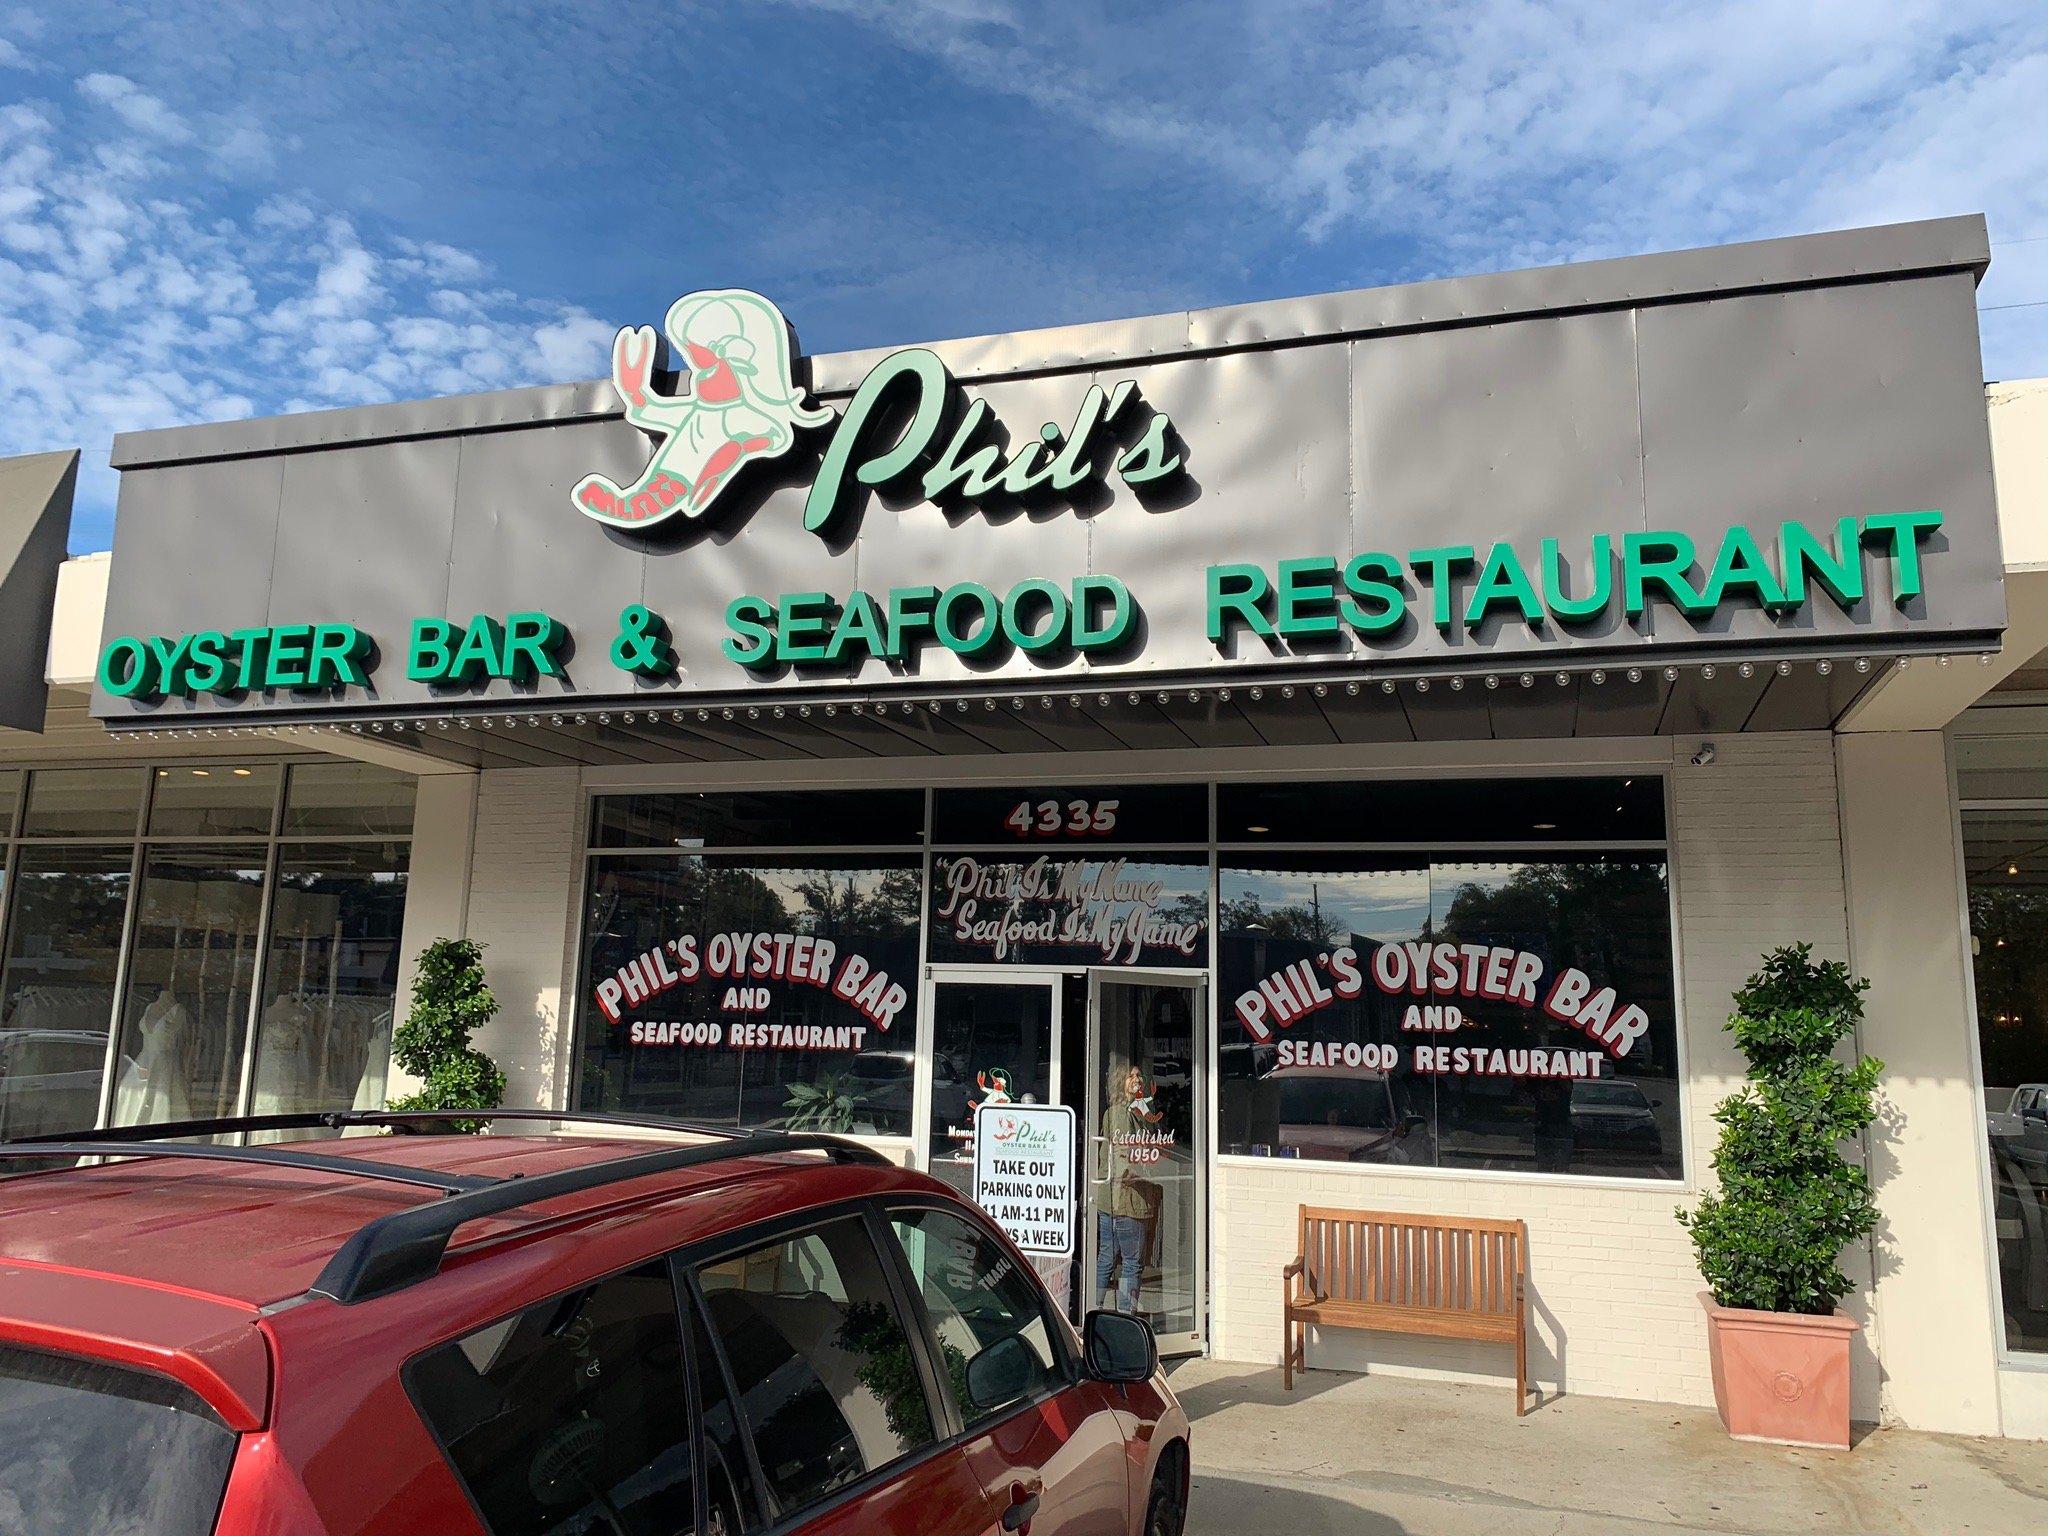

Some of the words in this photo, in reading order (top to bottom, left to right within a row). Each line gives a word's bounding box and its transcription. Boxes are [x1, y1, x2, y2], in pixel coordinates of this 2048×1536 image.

[803, 348, 1183, 532] Phil's
[100, 622, 366, 697] OYSTER
[407, 613, 560, 683] BAR
[610, 603, 668, 675] &
[721, 575, 1136, 669] SEAFOOD
[1206, 510, 1942, 641] RESTAURANT
[1005, 799, 1119, 837] 4335
[955, 899, 1057, 961] Seafood
[1087, 903, 1126, 962] My
[596, 934, 700, 1024] PHIL'S
[705, 932, 836, 985] OYSTER
[832, 954, 907, 1031] BAR
[721, 987, 771, 1011] AND
[1235, 947, 1362, 1042] PHIL'S
[1373, 942, 1544, 1007] OYSTER
[1544, 967, 1649, 1058] BAR
[1402, 1005, 1462, 1032] AND
[630, 1021, 722, 1046] SEAFOOD
[729, 1023, 867, 1050] RESTAURANT
[1277, 1040, 1398, 1071] SEAFOOD
[1415, 1046, 1604, 1078] RESTAURANT
[1015, 1121, 1056, 1142] Phil's
[1112, 1127, 1176, 1145] Established
[993, 1160, 1026, 1176] TAKE
[1029, 1161, 1055, 1177] OUT
[1130, 1148, 1160, 1164] 1950
[981, 1181, 1033, 1198] PARKING
[1036, 1184, 1066, 1200] ONLY
[1001, 1205, 1041, 1222] AM-11
[1044, 1207, 1064, 1223] PM
[1021, 1229, 1030, 1244] A
[1032, 1229, 1065, 1246] WEEK
